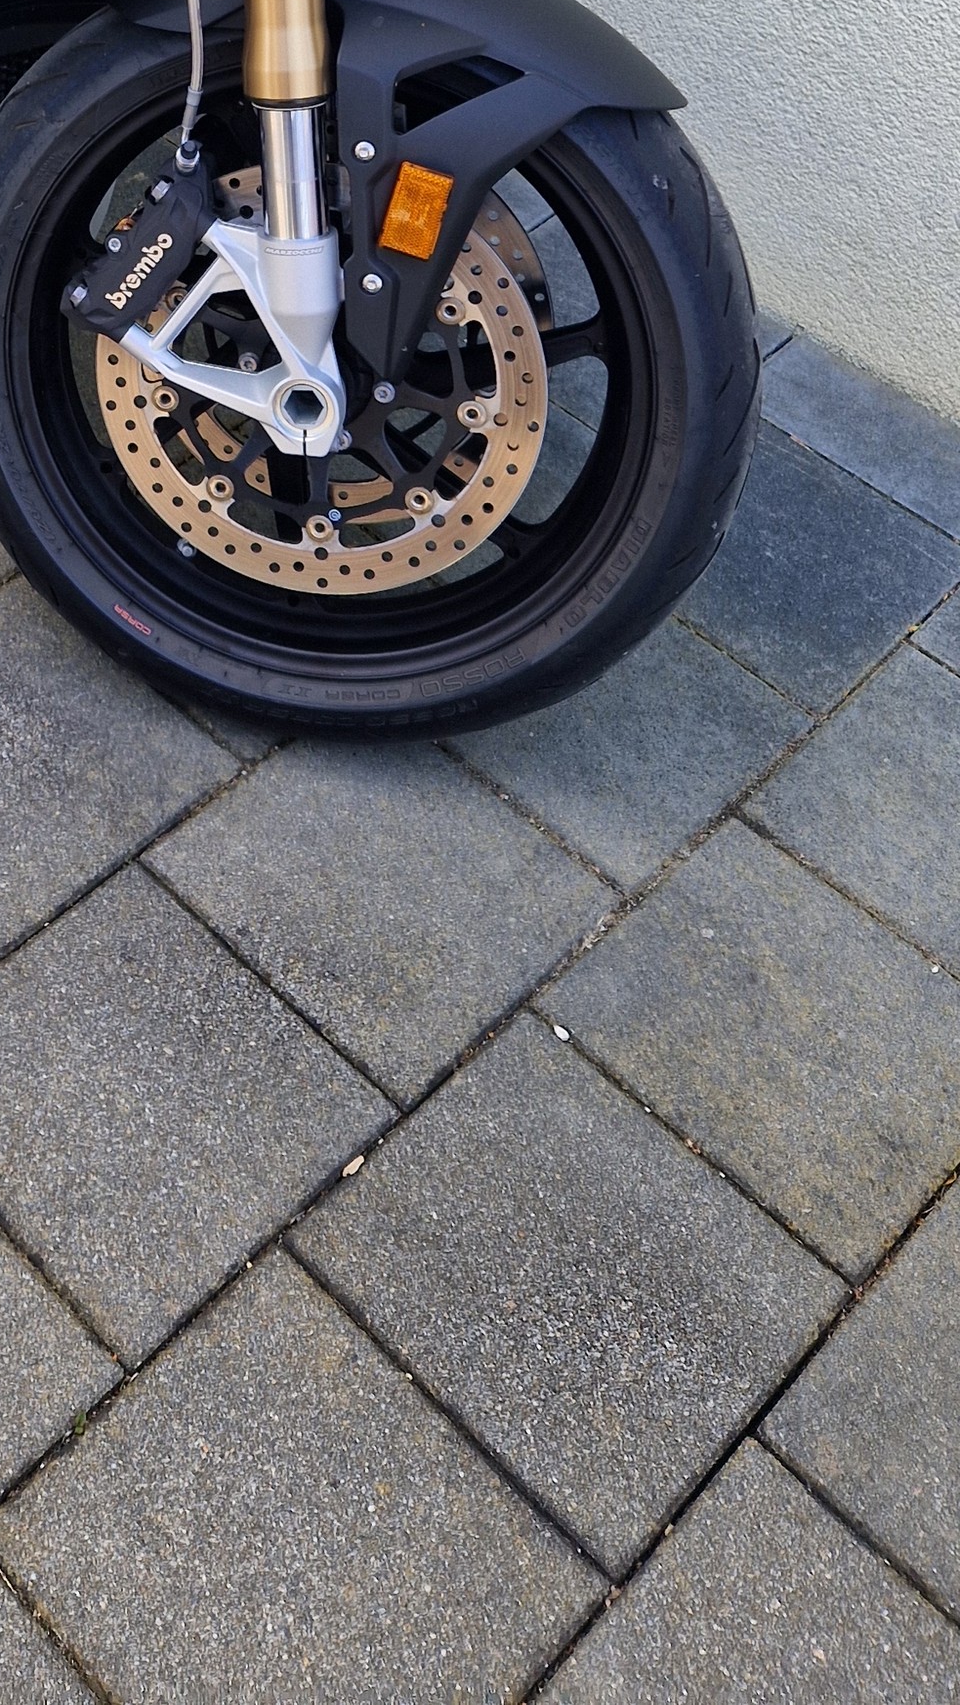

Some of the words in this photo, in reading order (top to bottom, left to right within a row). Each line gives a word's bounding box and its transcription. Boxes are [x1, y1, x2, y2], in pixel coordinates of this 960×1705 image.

[104, 233, 174, 311] brembo
[563, 518, 653, 628] DIABLO
[114, 604, 152, 635] CORSA
[325, 688, 401, 701] CORSA
[420, 647, 527, 699] ROSSO
